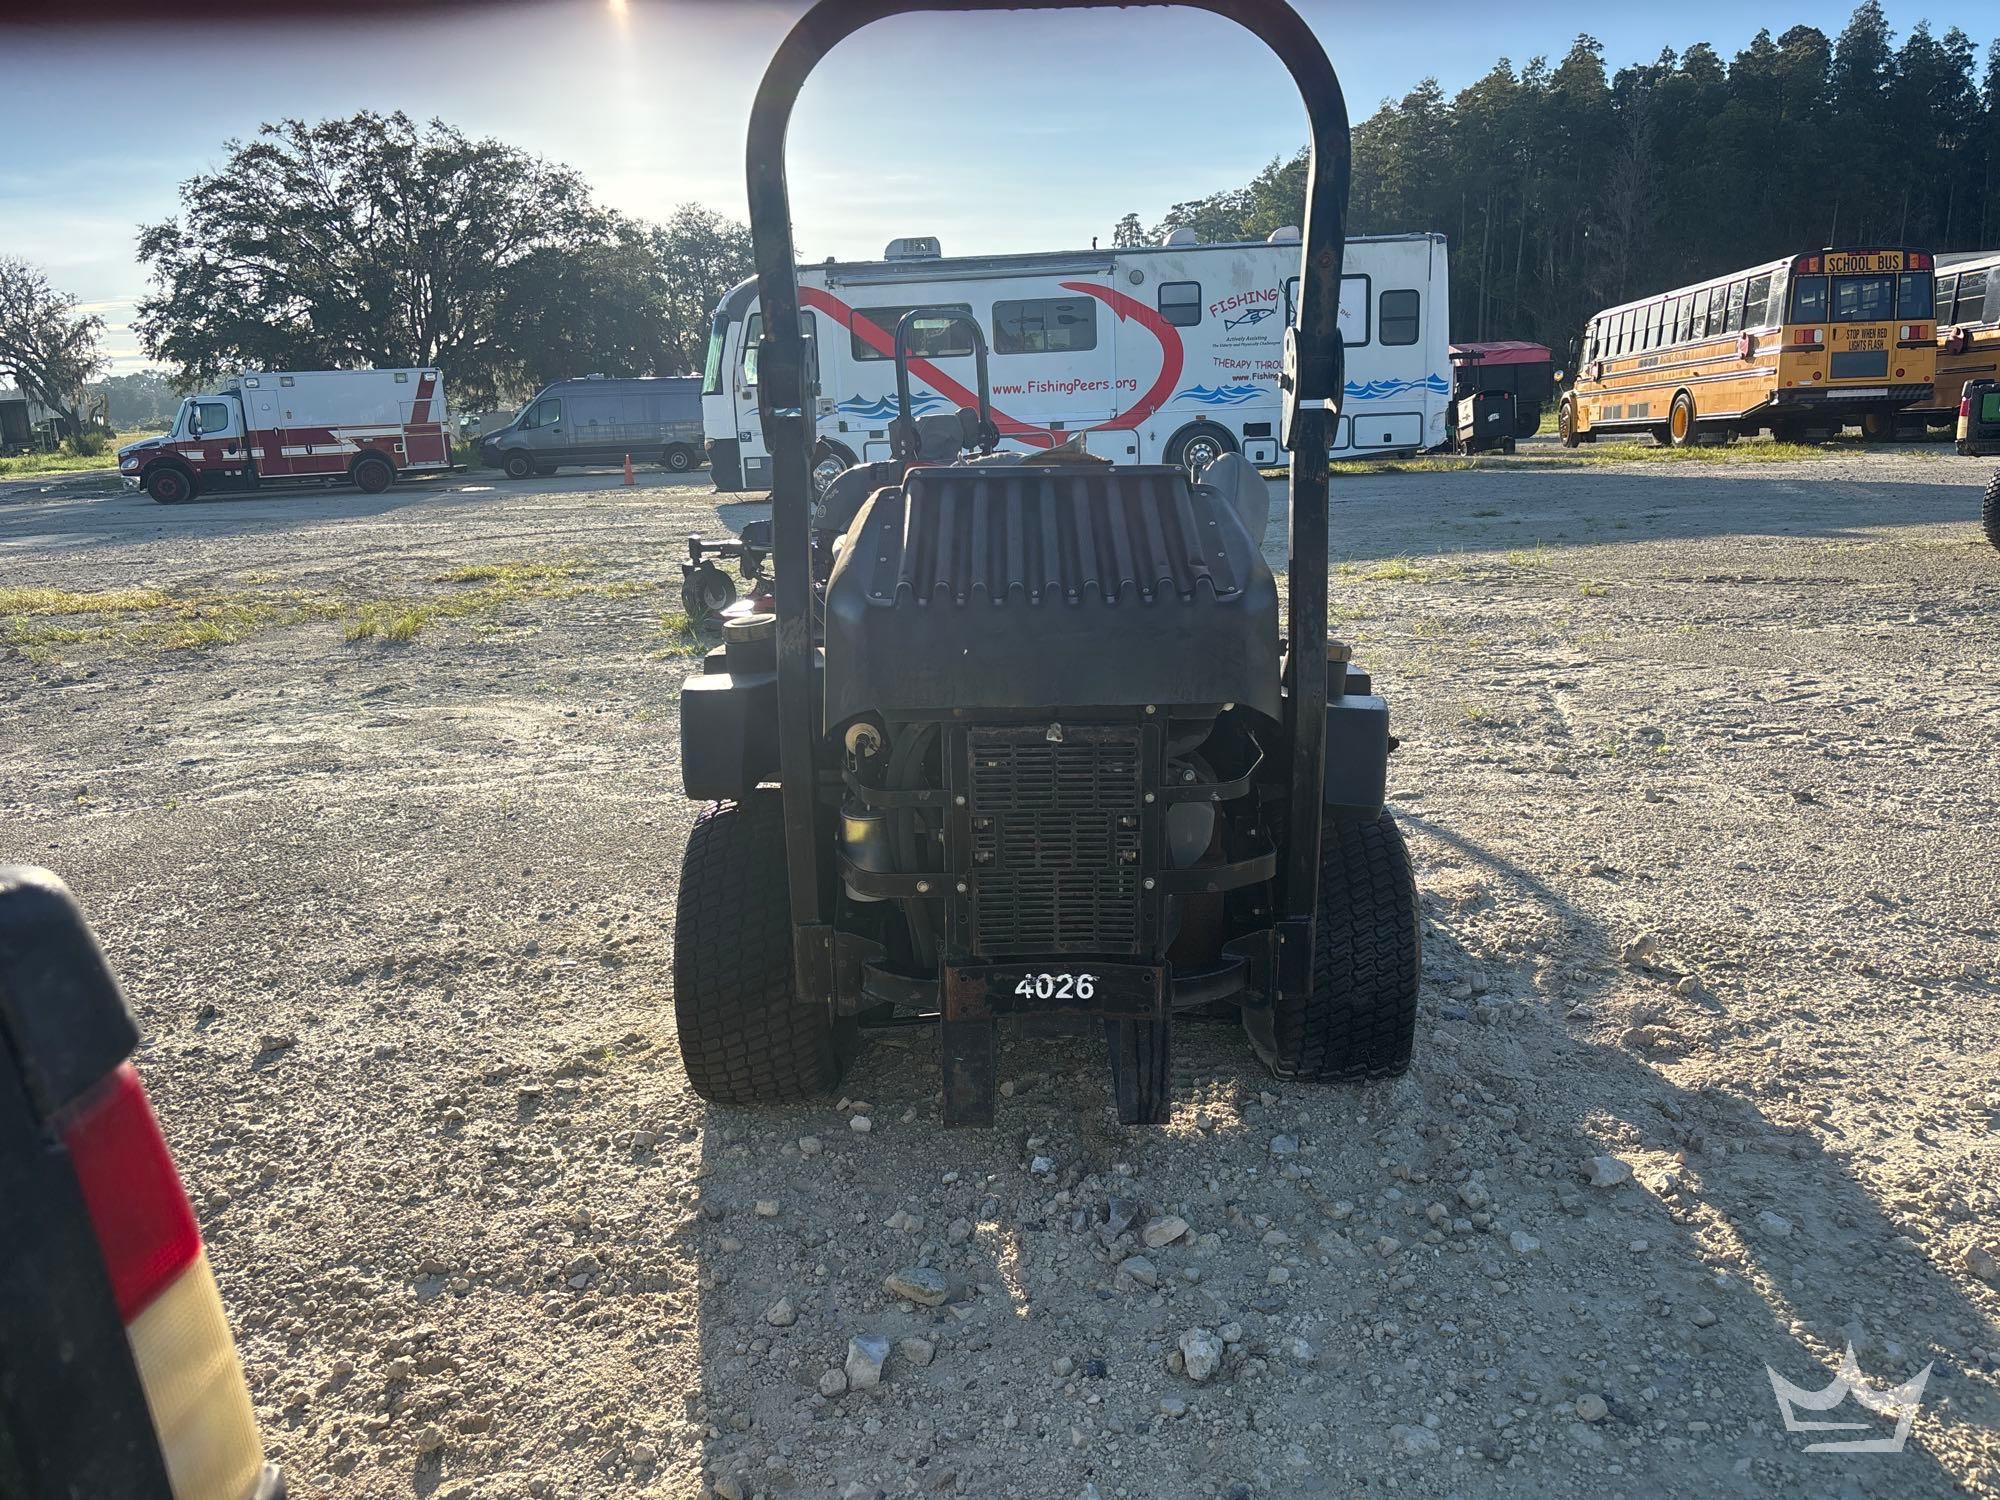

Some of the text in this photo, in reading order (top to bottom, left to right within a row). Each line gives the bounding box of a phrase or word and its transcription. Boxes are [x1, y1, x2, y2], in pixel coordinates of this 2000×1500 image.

[1829, 254, 1899, 272] SCHOOL BUS
[1209, 288, 1278, 318] FISHING
[1846, 327, 1888, 340] STOP WHEN RED
[1848, 339, 1884, 352] LIGHTS FLASH
[1213, 356, 1252, 370] THERAPY
[992, 378, 1137, 395] www.FishingPeers.org
[1014, 973, 1095, 999] 4026
